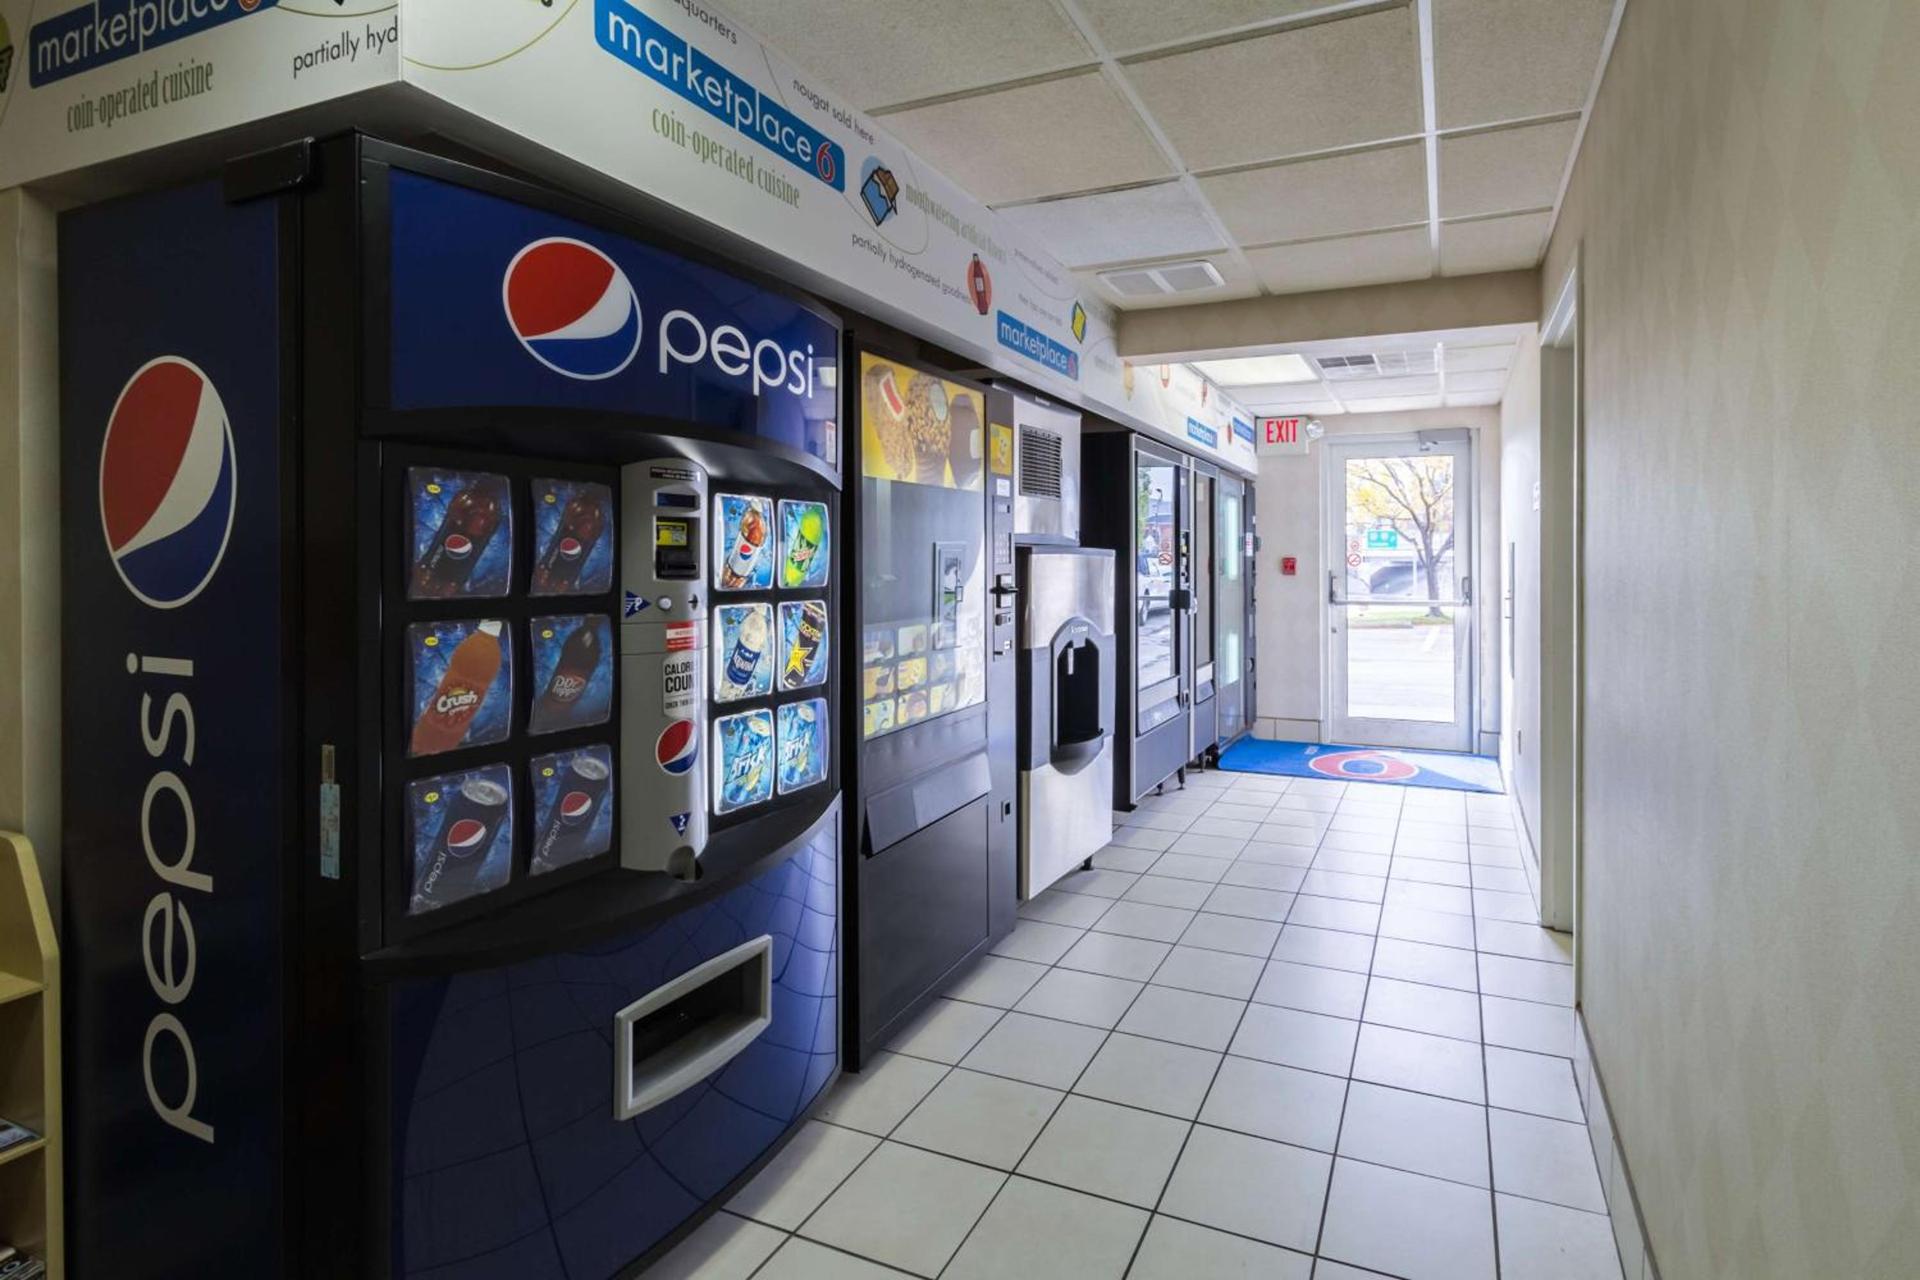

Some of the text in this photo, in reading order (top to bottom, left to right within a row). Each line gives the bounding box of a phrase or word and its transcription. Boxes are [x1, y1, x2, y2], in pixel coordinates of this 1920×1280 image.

[293, 14, 398, 79] partially hyd
[674, 0, 737, 45] quarters
[67, 57, 213, 132] coin-operated cuisine
[609, 11, 812, 162] marketplace
[793, 80, 830, 113] nougat
[832, 107, 852, 129] sold
[652, 108, 800, 209] coin-operated cuisine
[852, 233, 887, 264] partially
[659, 309, 813, 399] pepsi
[1001, 322, 1067, 370] marketplace
[1266, 419, 1298, 443] EXIT
[436, 690, 478, 713] Crush
[126, 652, 214, 1144] pepsi
